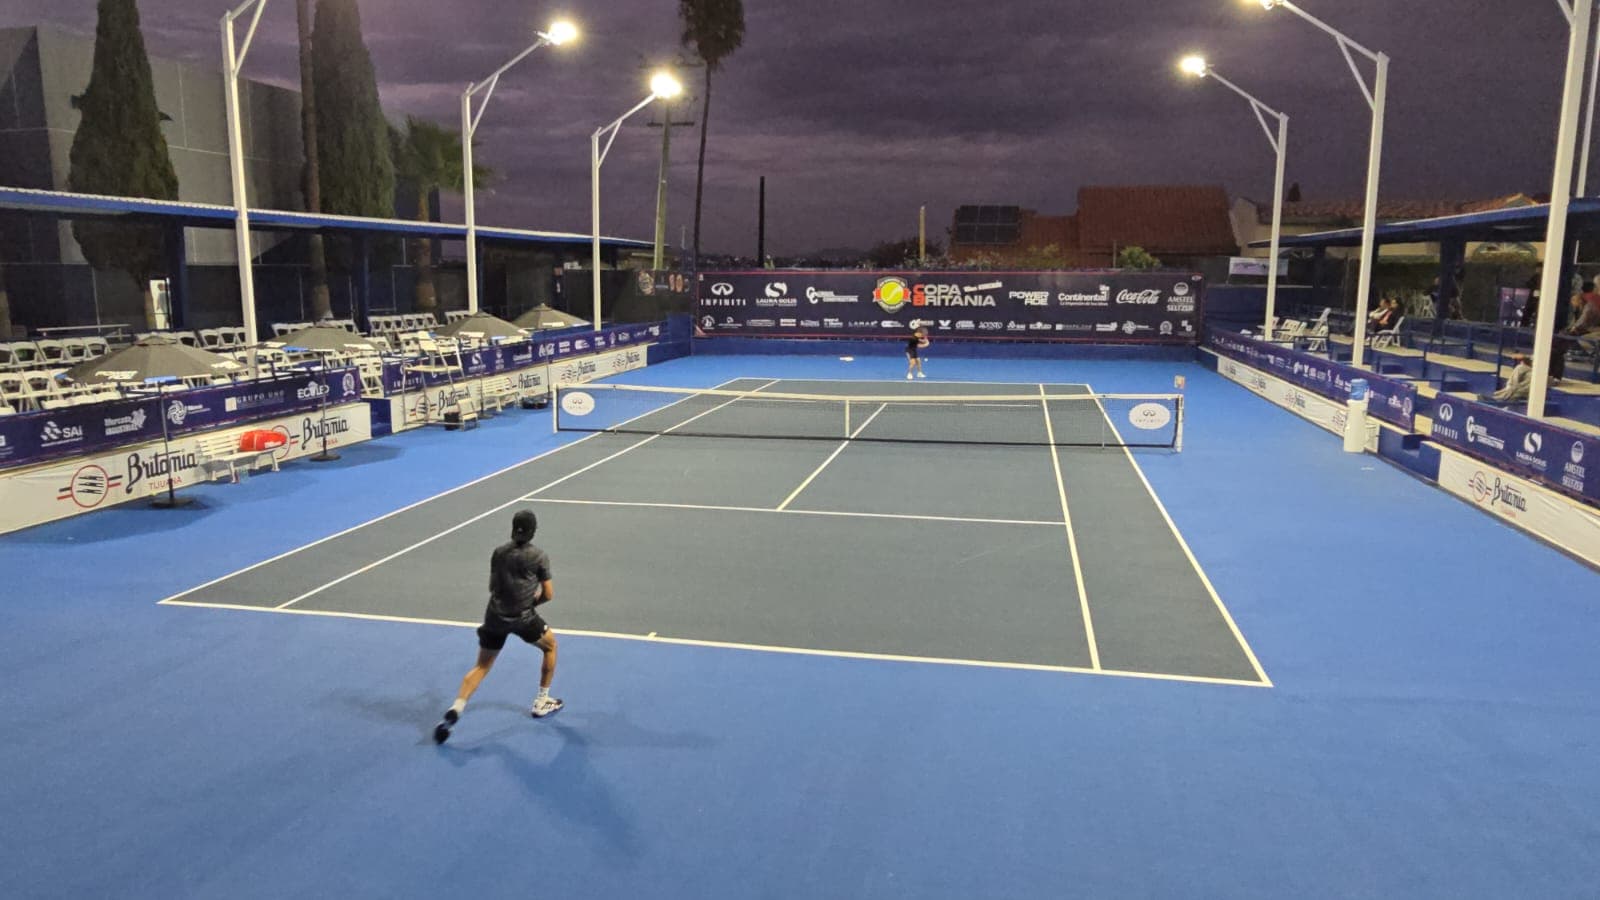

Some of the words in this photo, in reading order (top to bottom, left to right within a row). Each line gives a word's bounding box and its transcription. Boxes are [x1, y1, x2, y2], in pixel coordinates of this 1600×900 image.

[913, 284, 960, 296] COPA
[701, 298, 747, 306] INFINITI
[912, 295, 996, 307] BRITANIA
[125, 449, 199, 494] Britania
